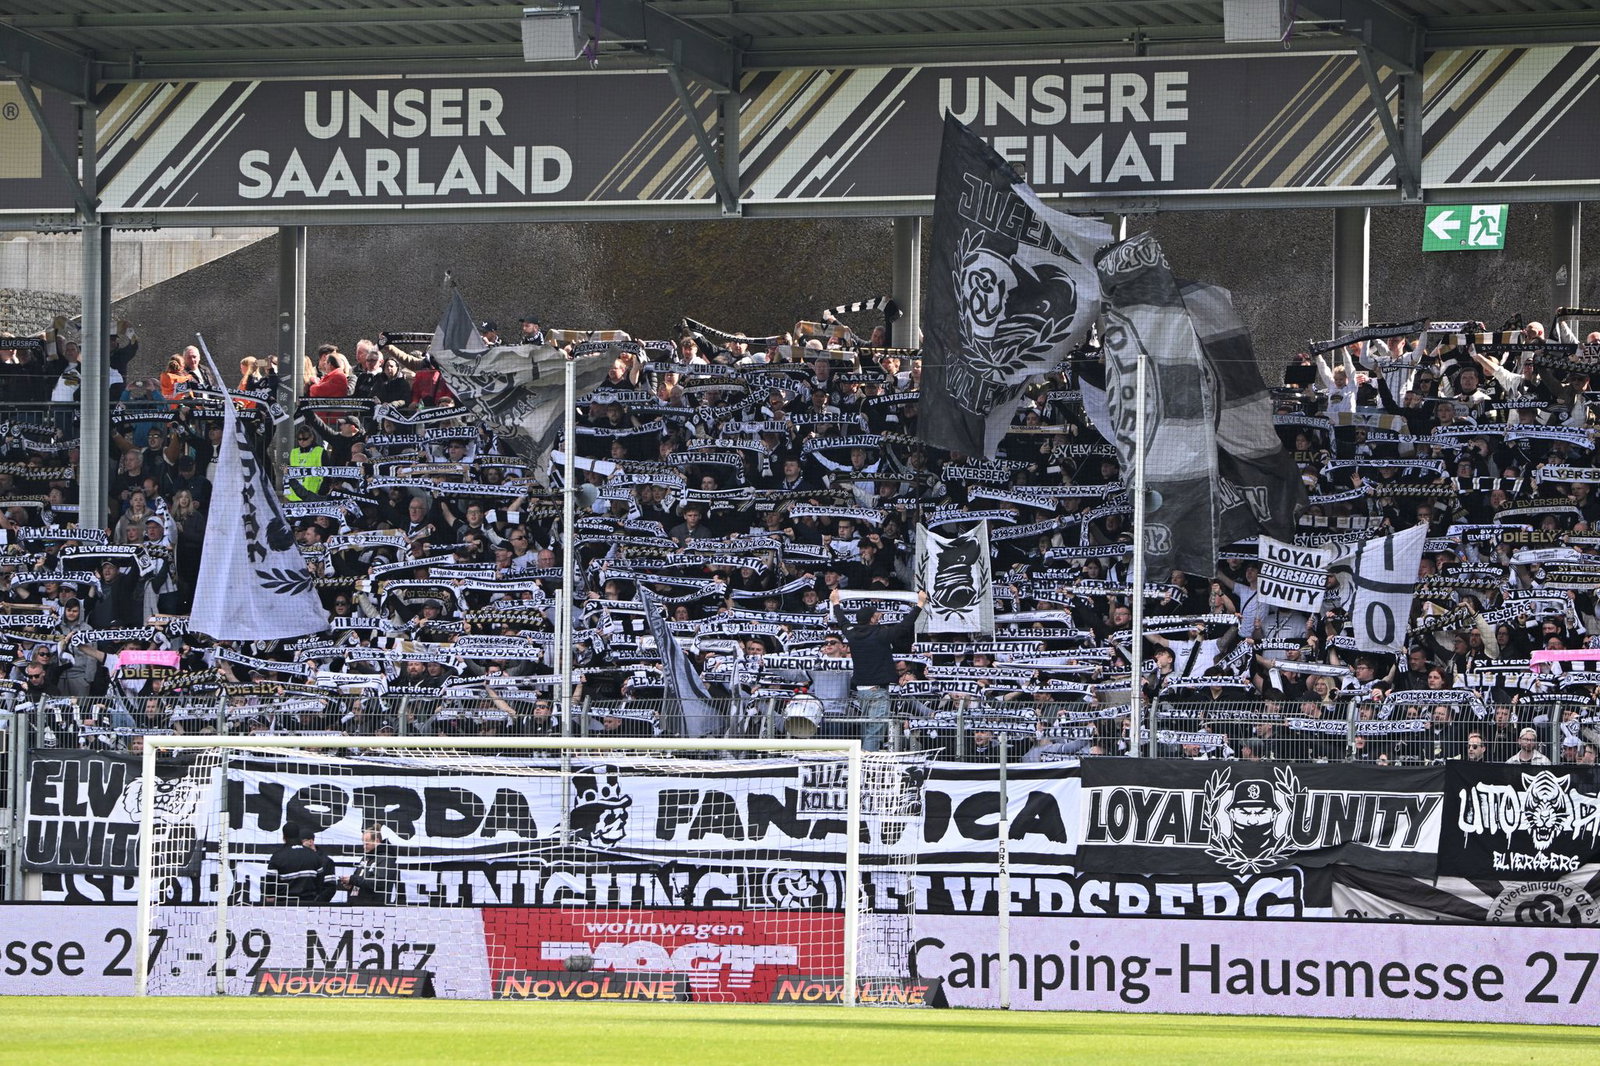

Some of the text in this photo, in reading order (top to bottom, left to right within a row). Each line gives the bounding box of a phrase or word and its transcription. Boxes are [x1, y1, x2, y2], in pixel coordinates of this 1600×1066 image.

[938, 71, 1189, 127] UNSERE
[304, 87, 507, 140] UNSER
[984, 130, 1188, 186] EIMAT
[238, 145, 573, 199] SAARLAND
[654, 362, 727, 375] ELV UNITED
[211, 385, 269, 400] ELERSBERG
[435, 406, 467, 417] SAARLAND
[789, 412, 859, 424] ELVERSBERG
[725, 423, 740, 432] ELV
[809, 435, 880, 449] RTVEREINIGU
[1367, 431, 1388, 440] BLOCK
[1070, 443, 1117, 455] ELVERSB
[850, 471, 914, 481] SAARLAND
[948, 467, 1011, 480] ELVERSBERG
[1541, 468, 1600, 480] ELVERSB
[1516, 498, 1578, 508] ELVERSBERG
[574, 524, 614, 533] VERSBERG
[1294, 536, 1309, 548] SV
[1503, 532, 1558, 543] DIE ELV
[64, 545, 137, 555] SV ELVERSBERG
[1053, 543, 1126, 558] ELVERSBERG
[17, 571, 93, 583] ELVERSBERG
[1259, 563, 1327, 587] ELVERSBERG
[1447, 567, 1503, 576] ELVERSBERG
[1460, 577, 1501, 586] SAARLAND
[1259, 582, 1320, 606] UNITY
[585, 601, 598, 611] SV
[1482, 602, 1531, 622] ERSBERG
[350, 617, 376, 627] BLOCK C
[507, 613, 543, 622] SAARLAND
[72, 629, 154, 646] SV ELVERSBERG
[283, 640, 334, 652] ELVERSBERG
[914, 641, 1042, 653] JUGEND KOLLEKTIV
[764, 657, 812, 671] JUGEND
[1475, 658, 1530, 667] SV ELVERS
[124, 668, 179, 678] DIE ELV
[227, 685, 251, 695] DIE
[284, 685, 330, 696] VERSBERG
[389, 680, 441, 697] versberg
[936, 681, 983, 695] KOLLEK
[1519, 694, 1591, 704] SV ELVERSBERG
[31, 759, 127, 818] ELV
[228, 780, 538, 840] HORDA
[1086, 788, 1445, 850] LOYAL UNITY
[1575, 893, 1592, 908] 07
[586, 920, 745, 939] wohnwagen
[0, 943, 85, 977] sse
[305, 929, 437, 973] März
[541, 941, 798, 989] VOGT
[911, 936, 1600, 1005] Camping-Hausmesse 27
[257, 969, 418, 997] NOVOLINE
[502, 974, 677, 1001] NOVOLINE
